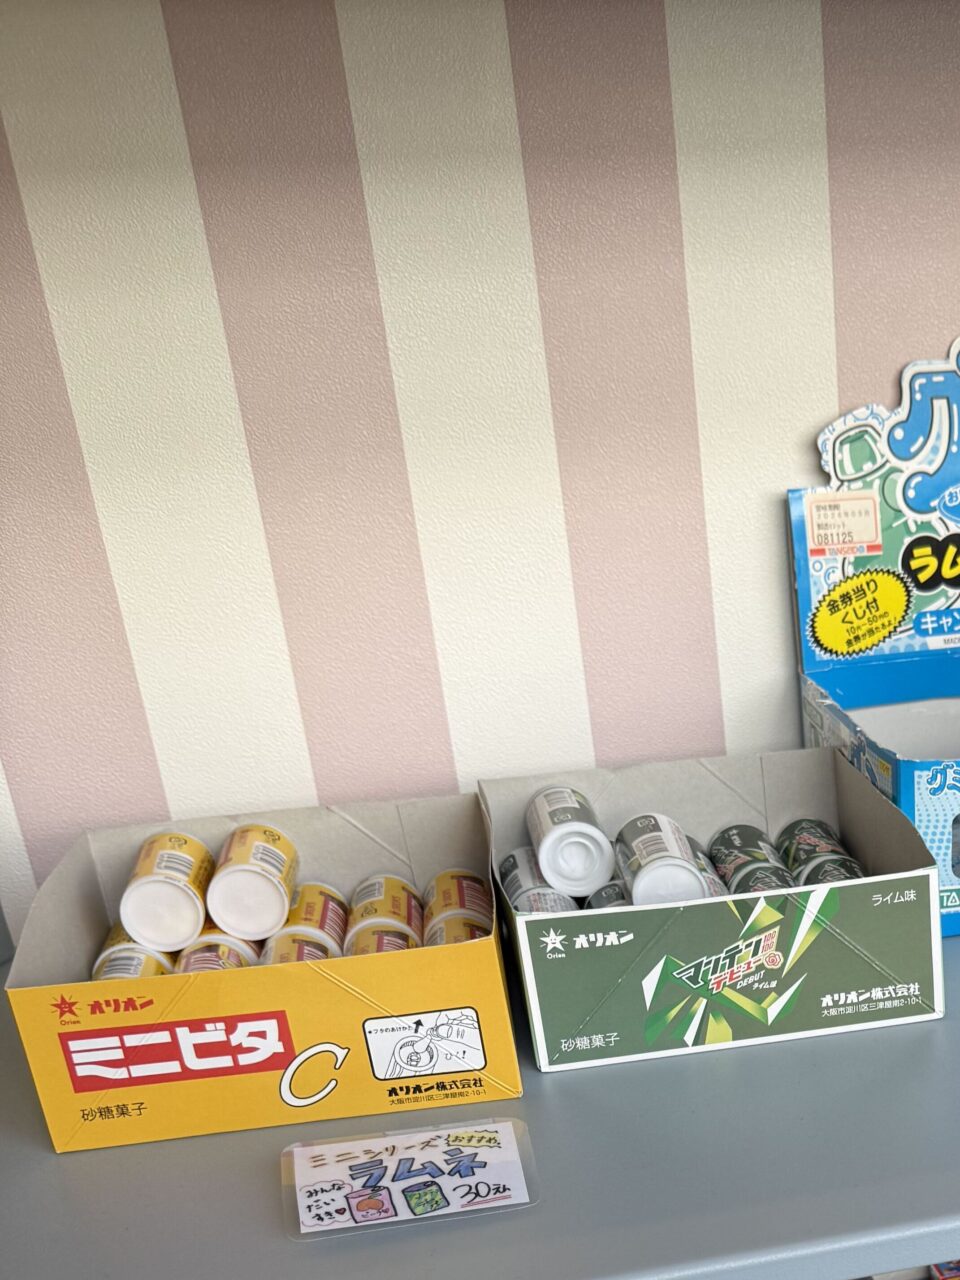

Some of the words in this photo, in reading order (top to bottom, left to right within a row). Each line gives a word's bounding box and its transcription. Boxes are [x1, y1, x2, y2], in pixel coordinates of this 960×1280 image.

[816, 531, 854, 546] 081125
[826, 578, 879, 615] 金券当り
[841, 599, 880, 626] くじ付
[871, 888, 918, 908] ライム味
[572, 929, 635, 950] オリオン
[736, 970, 767, 991] DEBUT
[87, 995, 155, 1017] オリオン
[820, 982, 922, 1008] オリオン株式会社
[66, 1017, 285, 1081] ミニビタ
[560, 1031, 621, 1053] 砂糖菓子
[279, 1041, 351, 1108] C
[386, 1076, 485, 1098] オリオン株式会社
[79, 1102, 149, 1123] 砂糖菓子
[309, 1134, 444, 1170] ミニシリーズ
[348, 1147, 488, 1189] ラムネ
[304, 1182, 347, 1199] みんな
